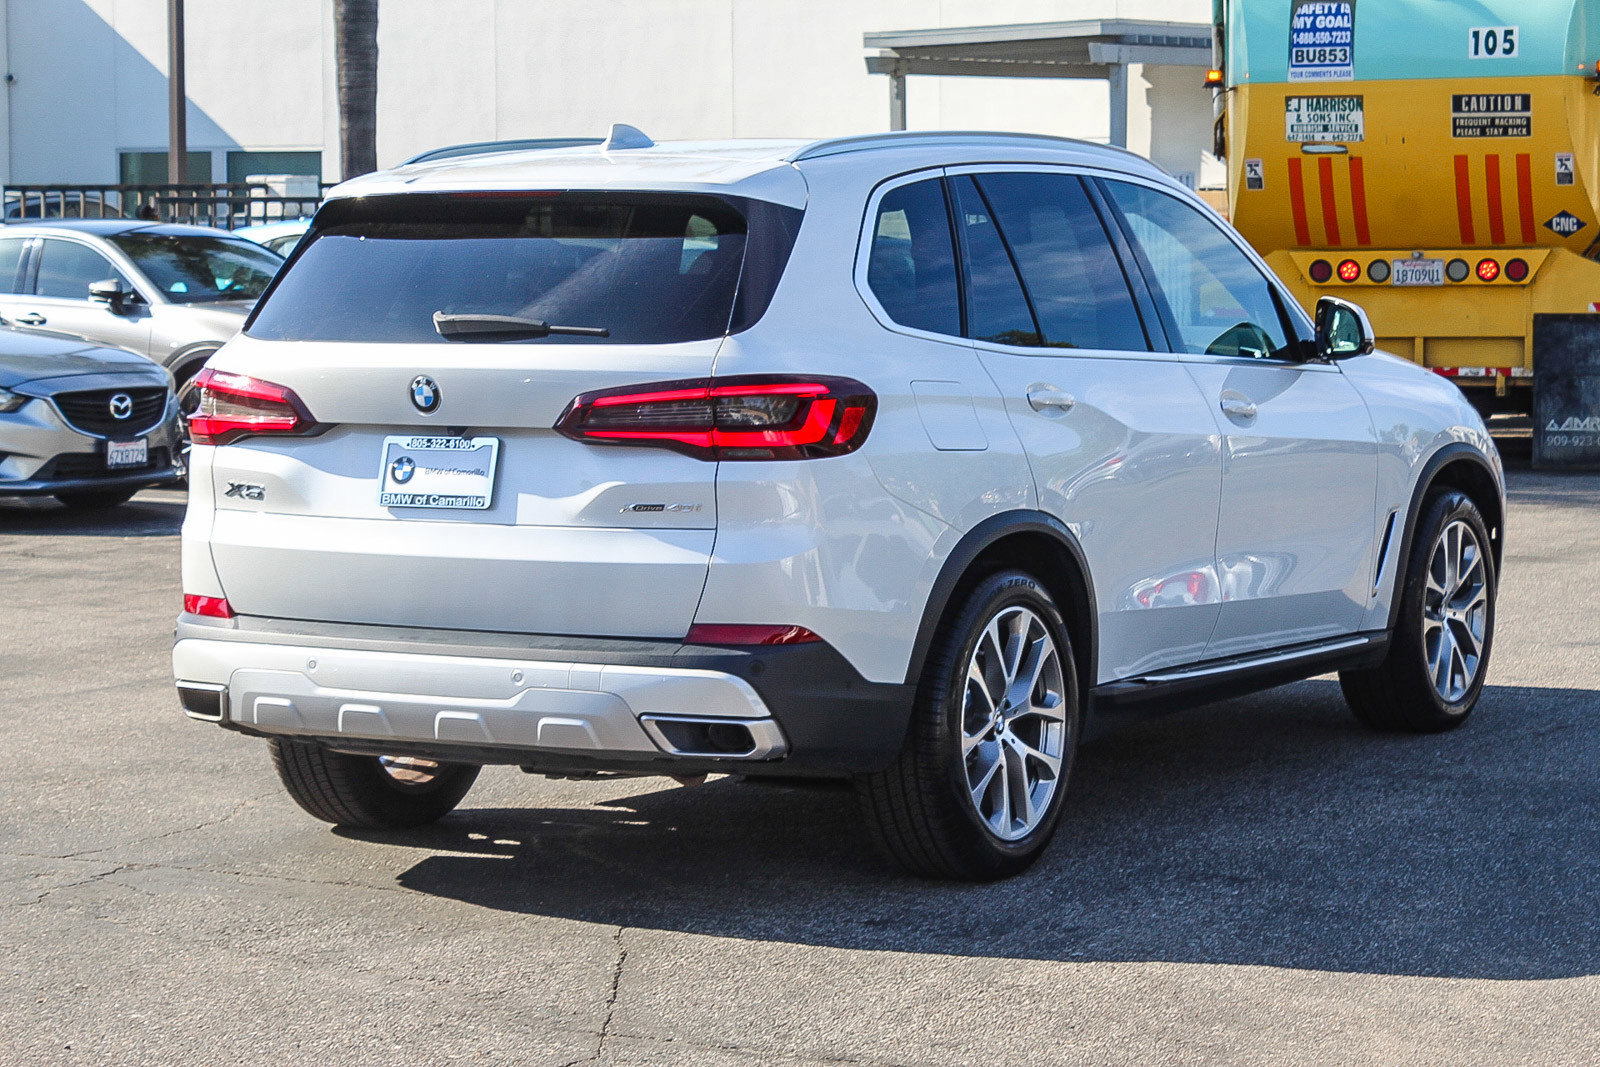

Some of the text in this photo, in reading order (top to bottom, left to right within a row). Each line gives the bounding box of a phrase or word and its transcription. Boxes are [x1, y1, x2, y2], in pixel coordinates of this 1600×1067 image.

[1293, 14, 1352, 29] MY GOAL
[1472, 29, 1515, 56] 105
[1295, 48, 1348, 63] BU853
[1290, 71, 1304, 79] YOUR
[1333, 70, 1352, 78] PLEASE
[1306, 97, 1363, 112] HARRISON
[1461, 95, 1522, 112] CAUTION
[1296, 113, 1356, 123] & SONS INC.
[1456, 118, 1491, 126] FREQUENT
[1456, 127, 1527, 136] PLEASE STAY BACK
[411, 439, 470, 449] 805-322-6100
[1545, 435, 1600, 447] 909-923-
[425, 467, 486, 476] BMW of Camarillo
[224, 479, 266, 501] X5
[382, 494, 484, 508] BMW of Camarillo
